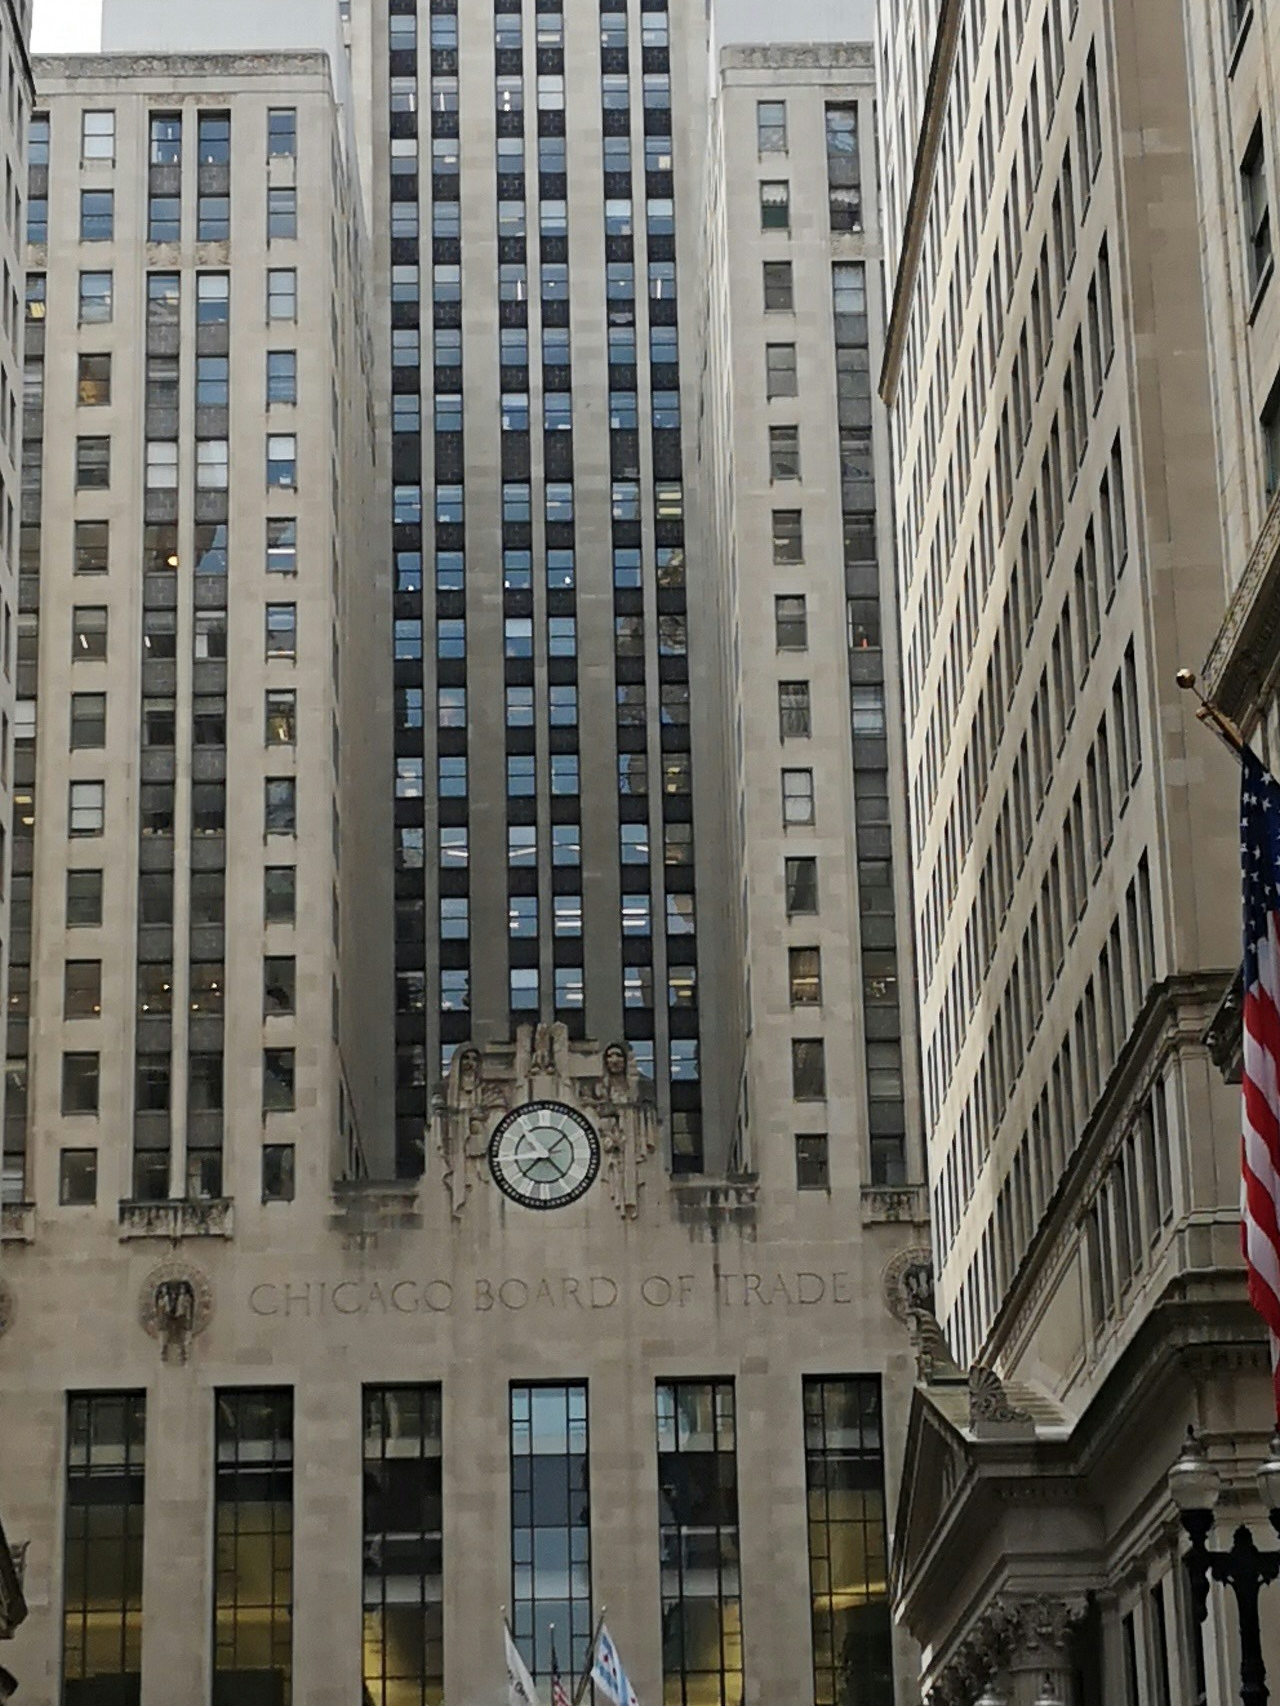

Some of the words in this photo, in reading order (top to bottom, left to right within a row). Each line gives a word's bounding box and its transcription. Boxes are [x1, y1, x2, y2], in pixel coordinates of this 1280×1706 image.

[248, 1279, 455, 1317] CHICAGO
[474, 1275, 620, 1313] BOARD
[640, 1273, 696, 1309] OF
[718, 1270, 853, 1307] TRADE
